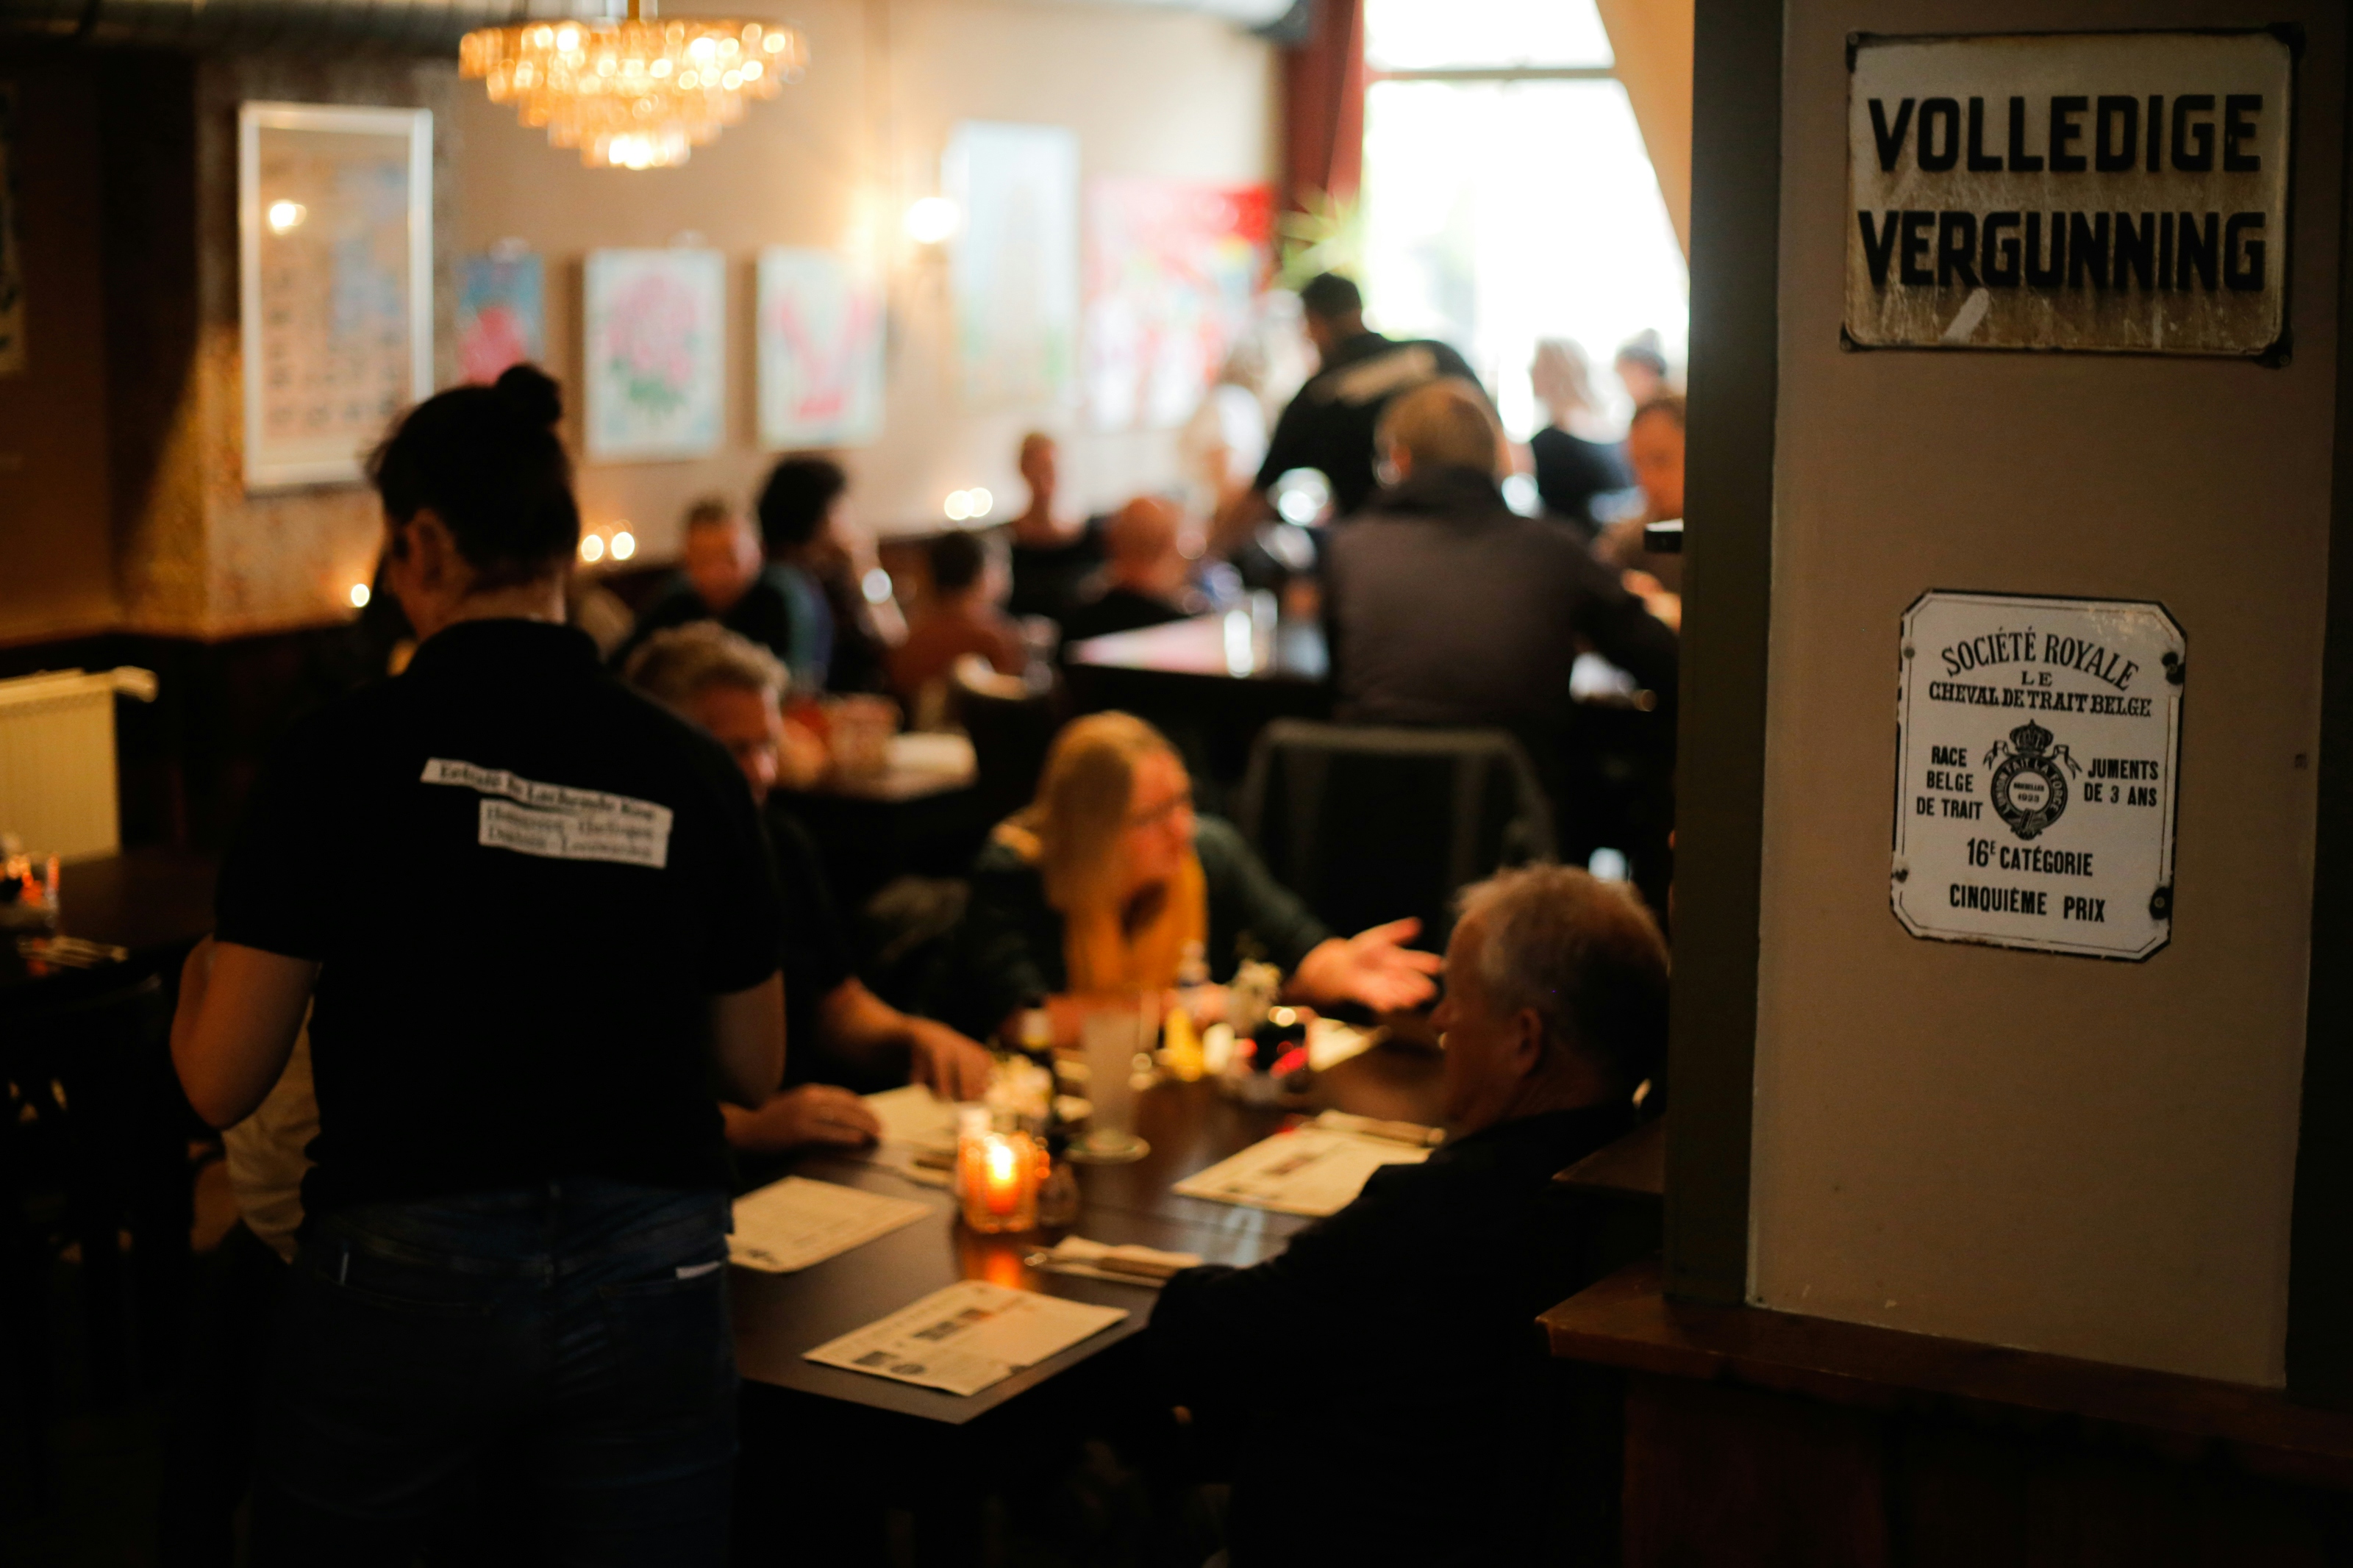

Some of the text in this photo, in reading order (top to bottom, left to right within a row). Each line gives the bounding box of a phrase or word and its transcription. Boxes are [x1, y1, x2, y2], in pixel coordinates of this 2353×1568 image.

[1868, 94, 2263, 172] VOLLEDIGE
[1857, 210, 2265, 292] VERGUNNING
[1941, 626, 2139, 691] SOCIÉTÉ ROYALE
[2021, 670, 2053, 686] LE
[1929, 681, 2152, 717] CHEVAL DE TRAIT BELGE
[1932, 745, 1968, 767] RACE
[2088, 758, 2159, 780] JUMENTS
[1927, 770, 1974, 792] BELGE
[2084, 782, 2157, 806] DE 3 ANS
[1916, 797, 1983, 820] DE TRAIT
[2000, 845, 2093, 877] CATÉGORIE
[2063, 895, 2105, 923] PRIX
